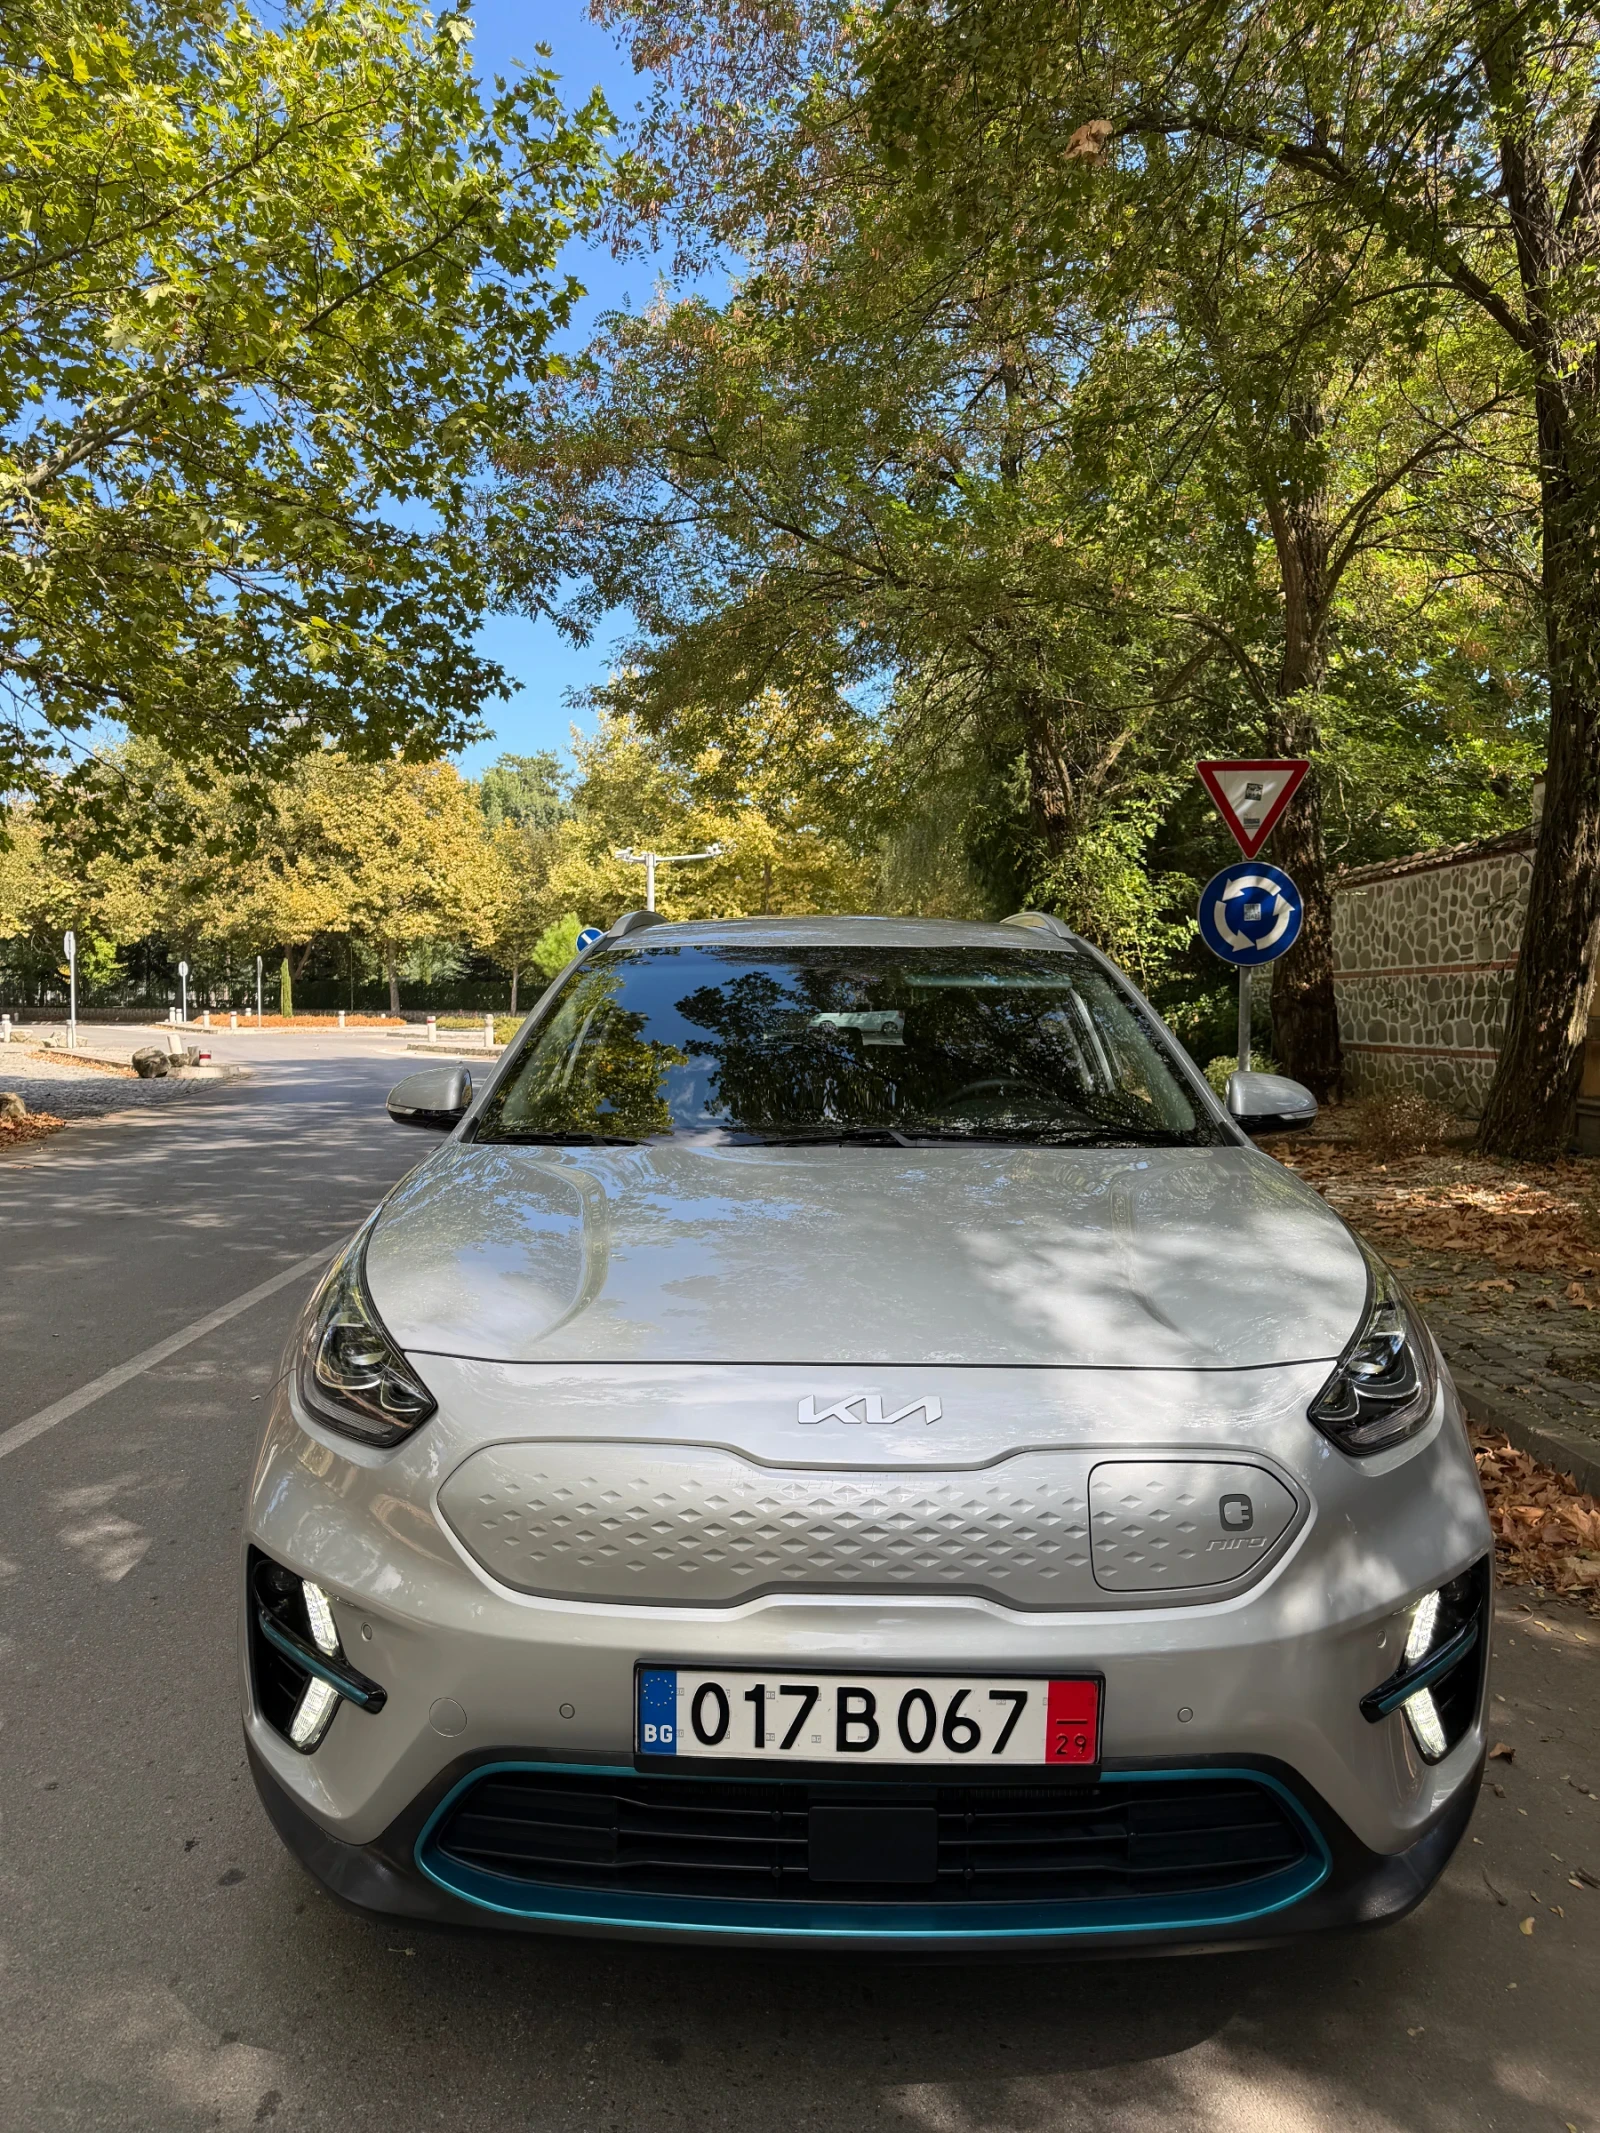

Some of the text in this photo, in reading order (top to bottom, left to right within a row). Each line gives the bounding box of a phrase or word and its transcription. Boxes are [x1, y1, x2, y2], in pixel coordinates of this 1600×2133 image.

[798, 1394, 942, 1425] KIA
[644, 1723, 673, 1744] BG
[1055, 1733, 1087, 1755] 29
